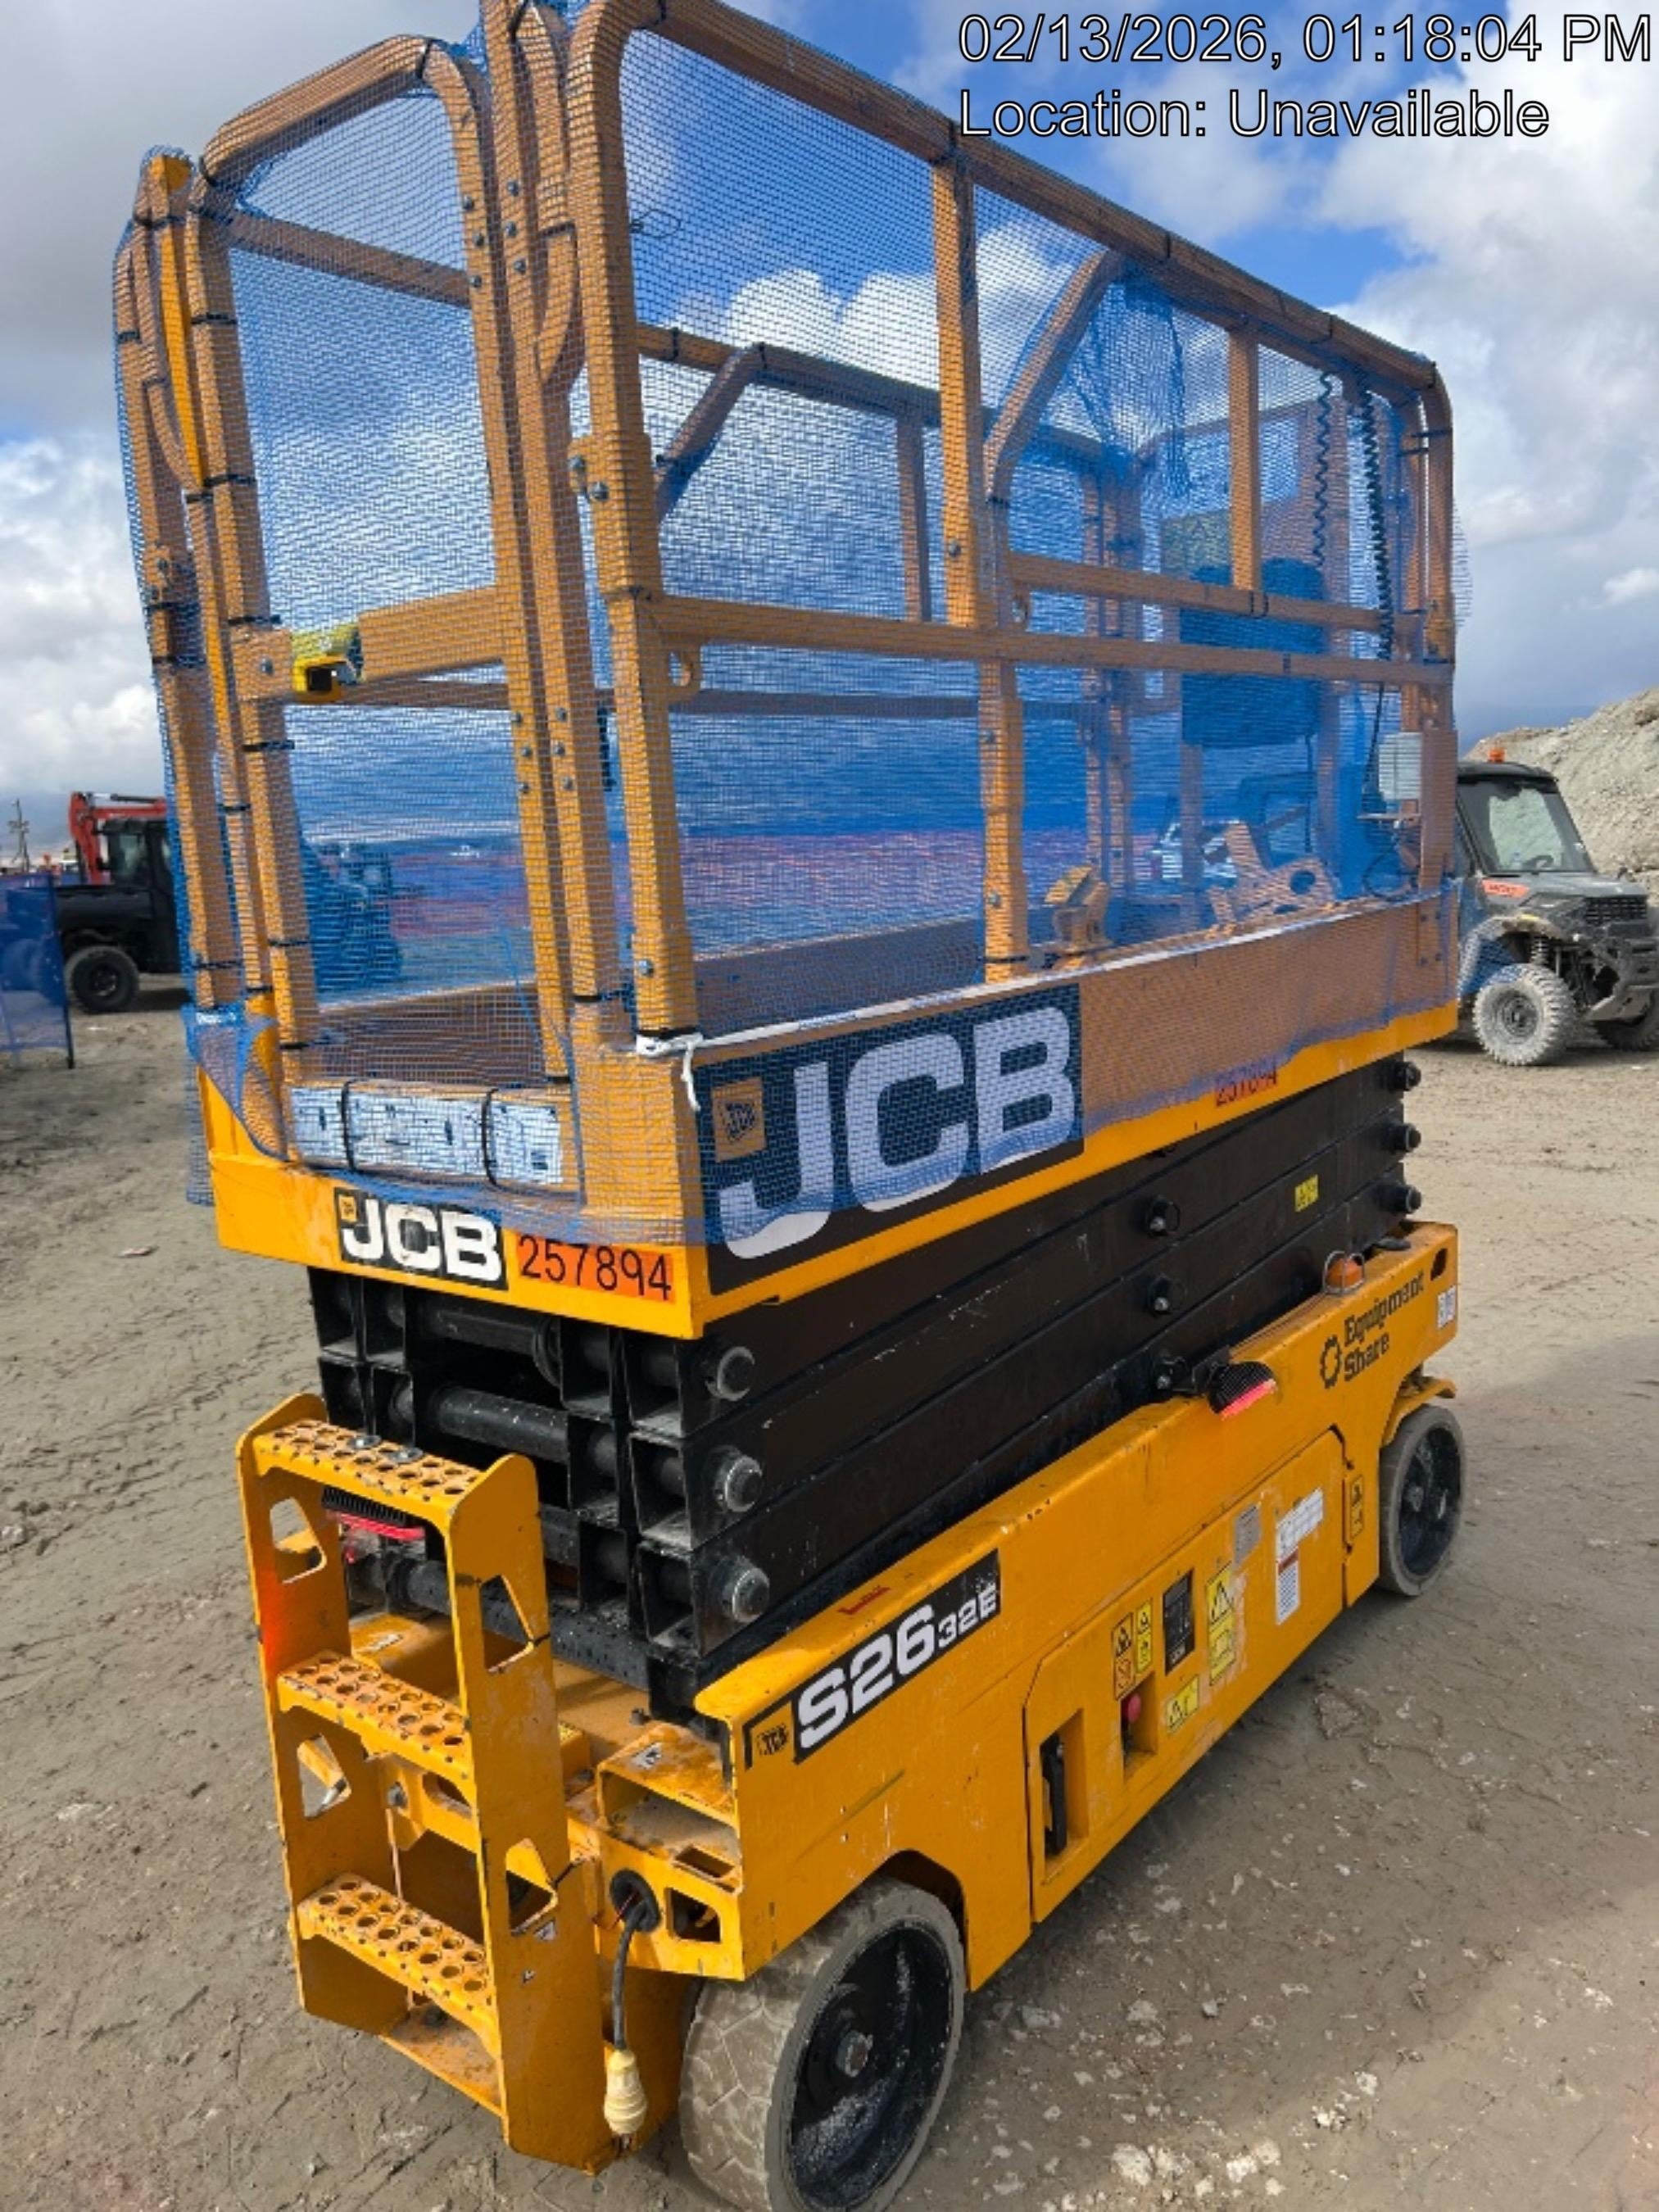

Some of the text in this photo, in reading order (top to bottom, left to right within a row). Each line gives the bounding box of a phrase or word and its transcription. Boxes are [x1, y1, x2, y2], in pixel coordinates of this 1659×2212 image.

[718, 1007, 1076, 1259] JCB
[342, 1198, 502, 1282] JCB
[518, 1234, 673, 1301] 257894
[1344, 1270, 1424, 1348] Equipment
[1344, 1333, 1389, 1382] Share
